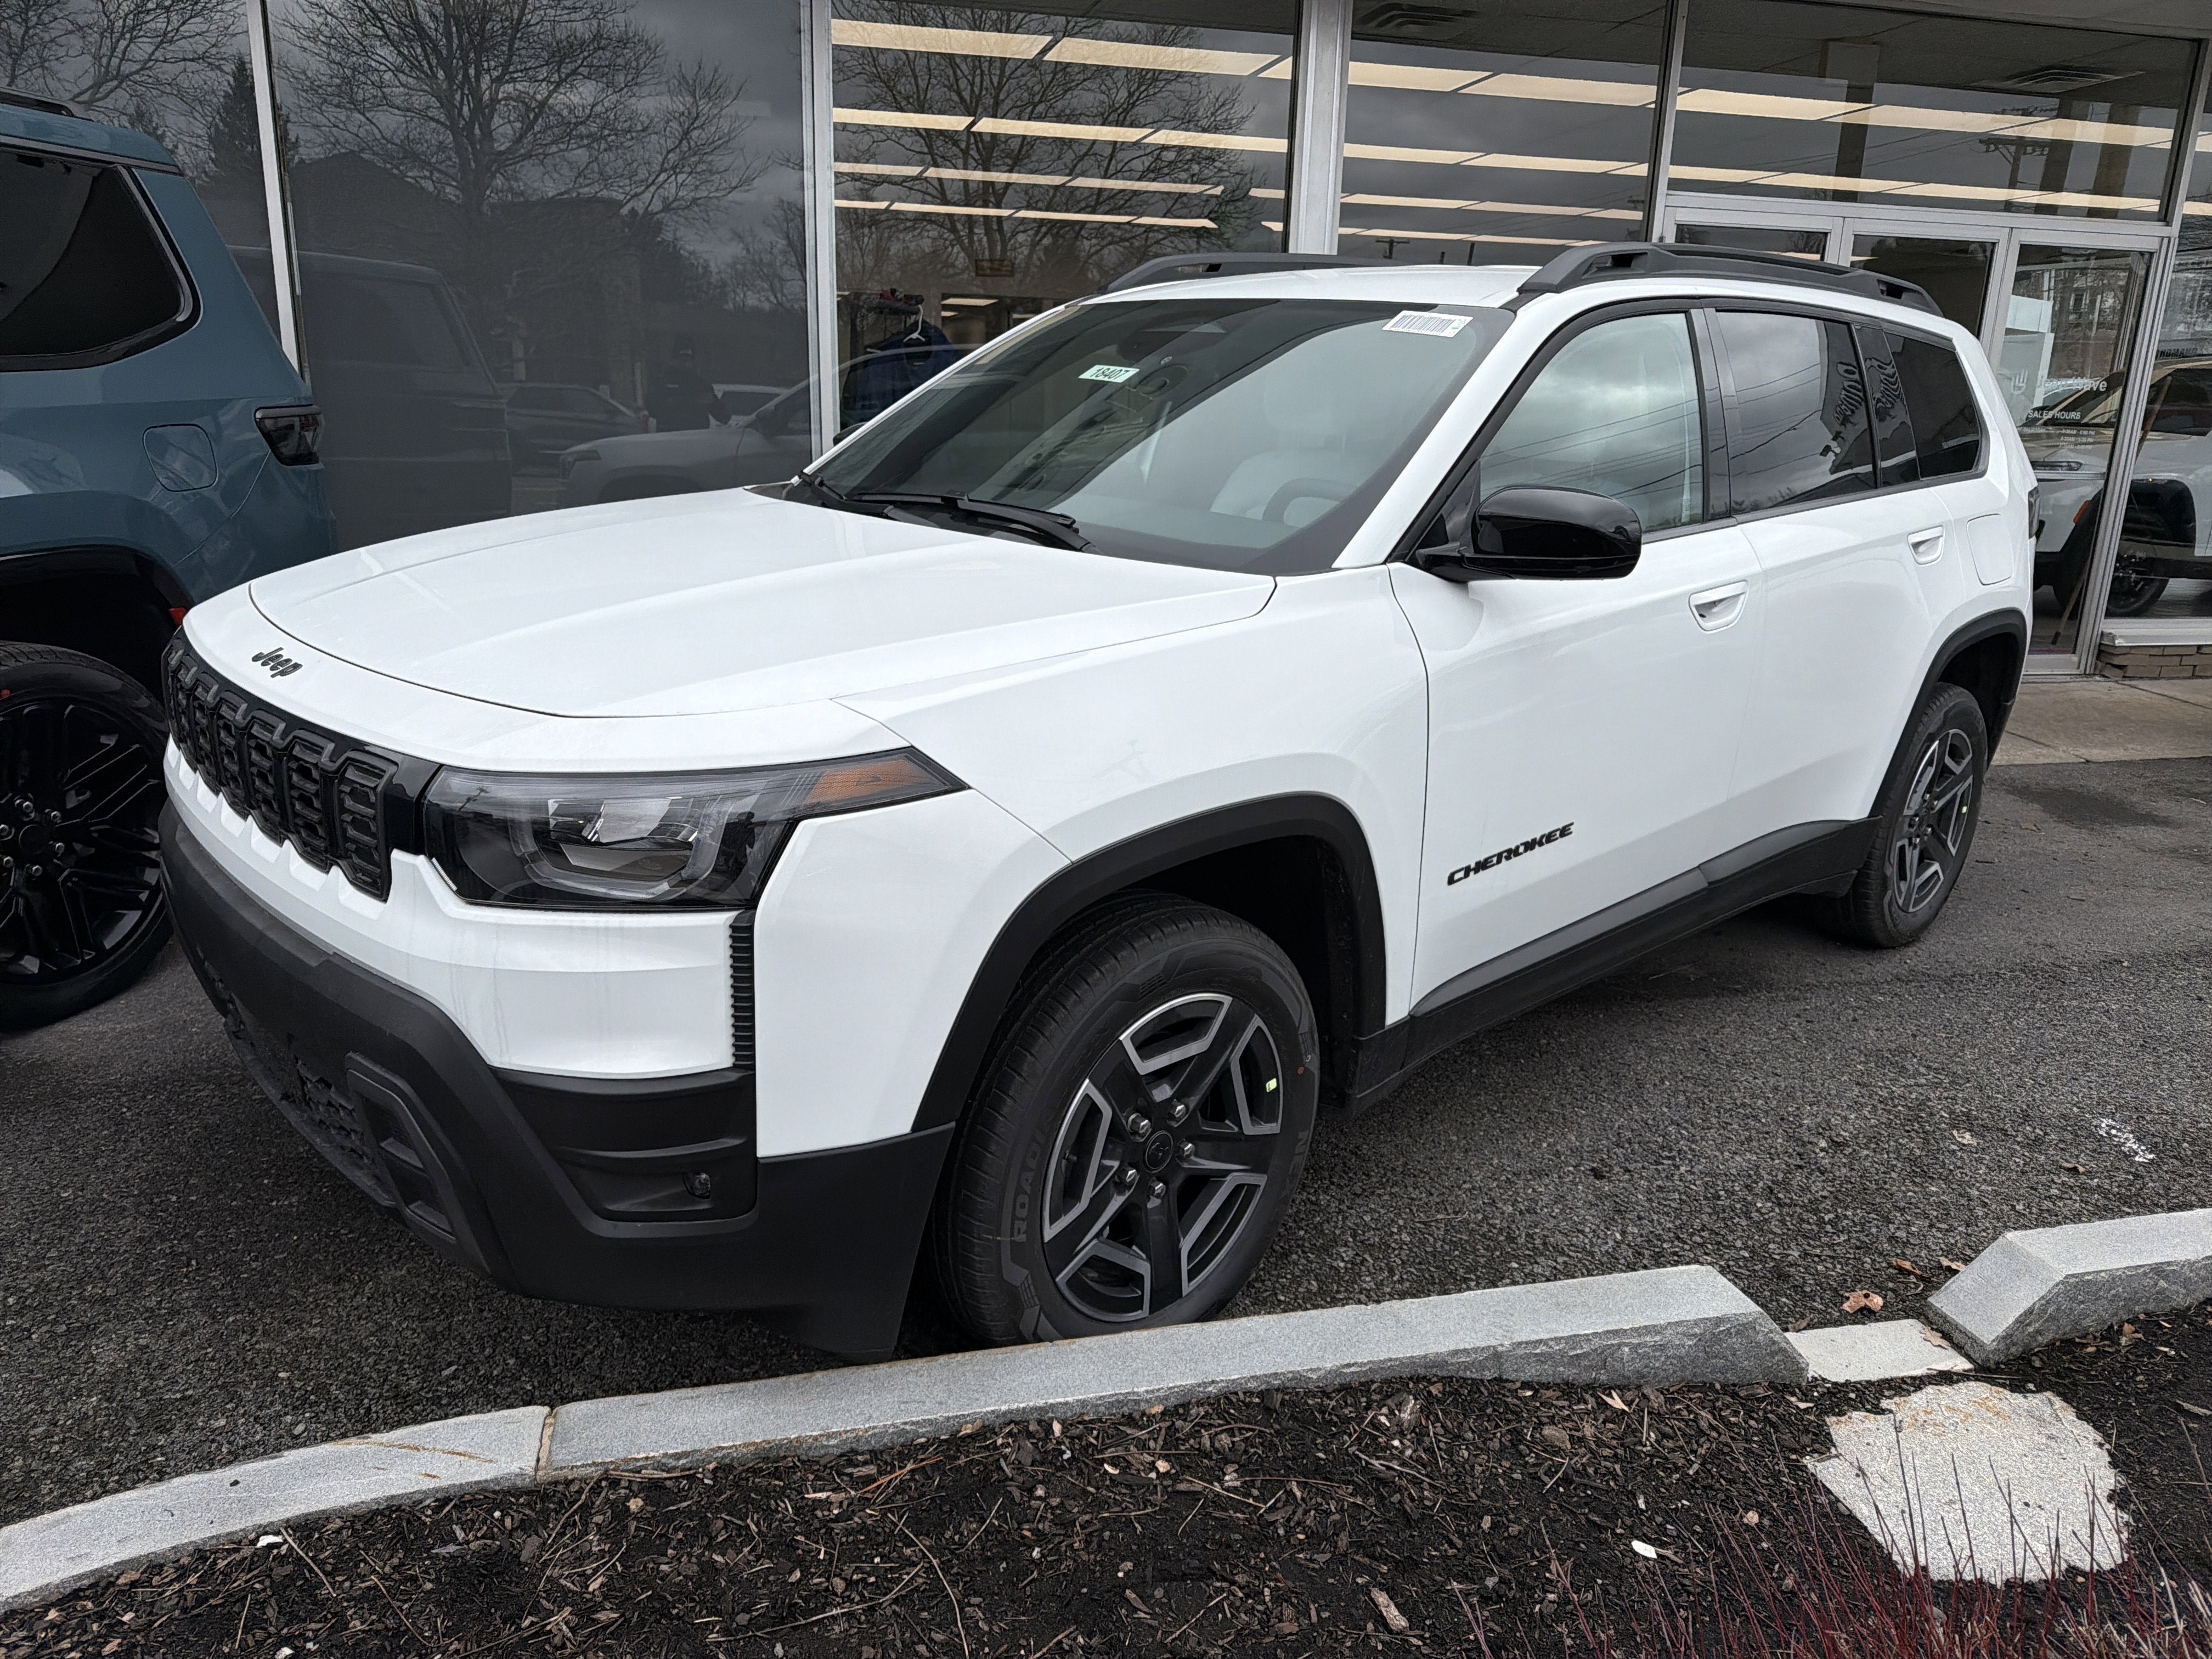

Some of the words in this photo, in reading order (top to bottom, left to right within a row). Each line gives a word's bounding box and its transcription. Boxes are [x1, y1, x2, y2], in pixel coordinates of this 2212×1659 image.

[1090, 367, 1130, 380] 18407
[2072, 377, 2107, 392] Wave
[2028, 410, 2053, 419] SALES
[2055, 411, 2081, 420] HOURS
[251, 647, 303, 679] Jeep
[1447, 821, 1575, 886] CHEROKEE
